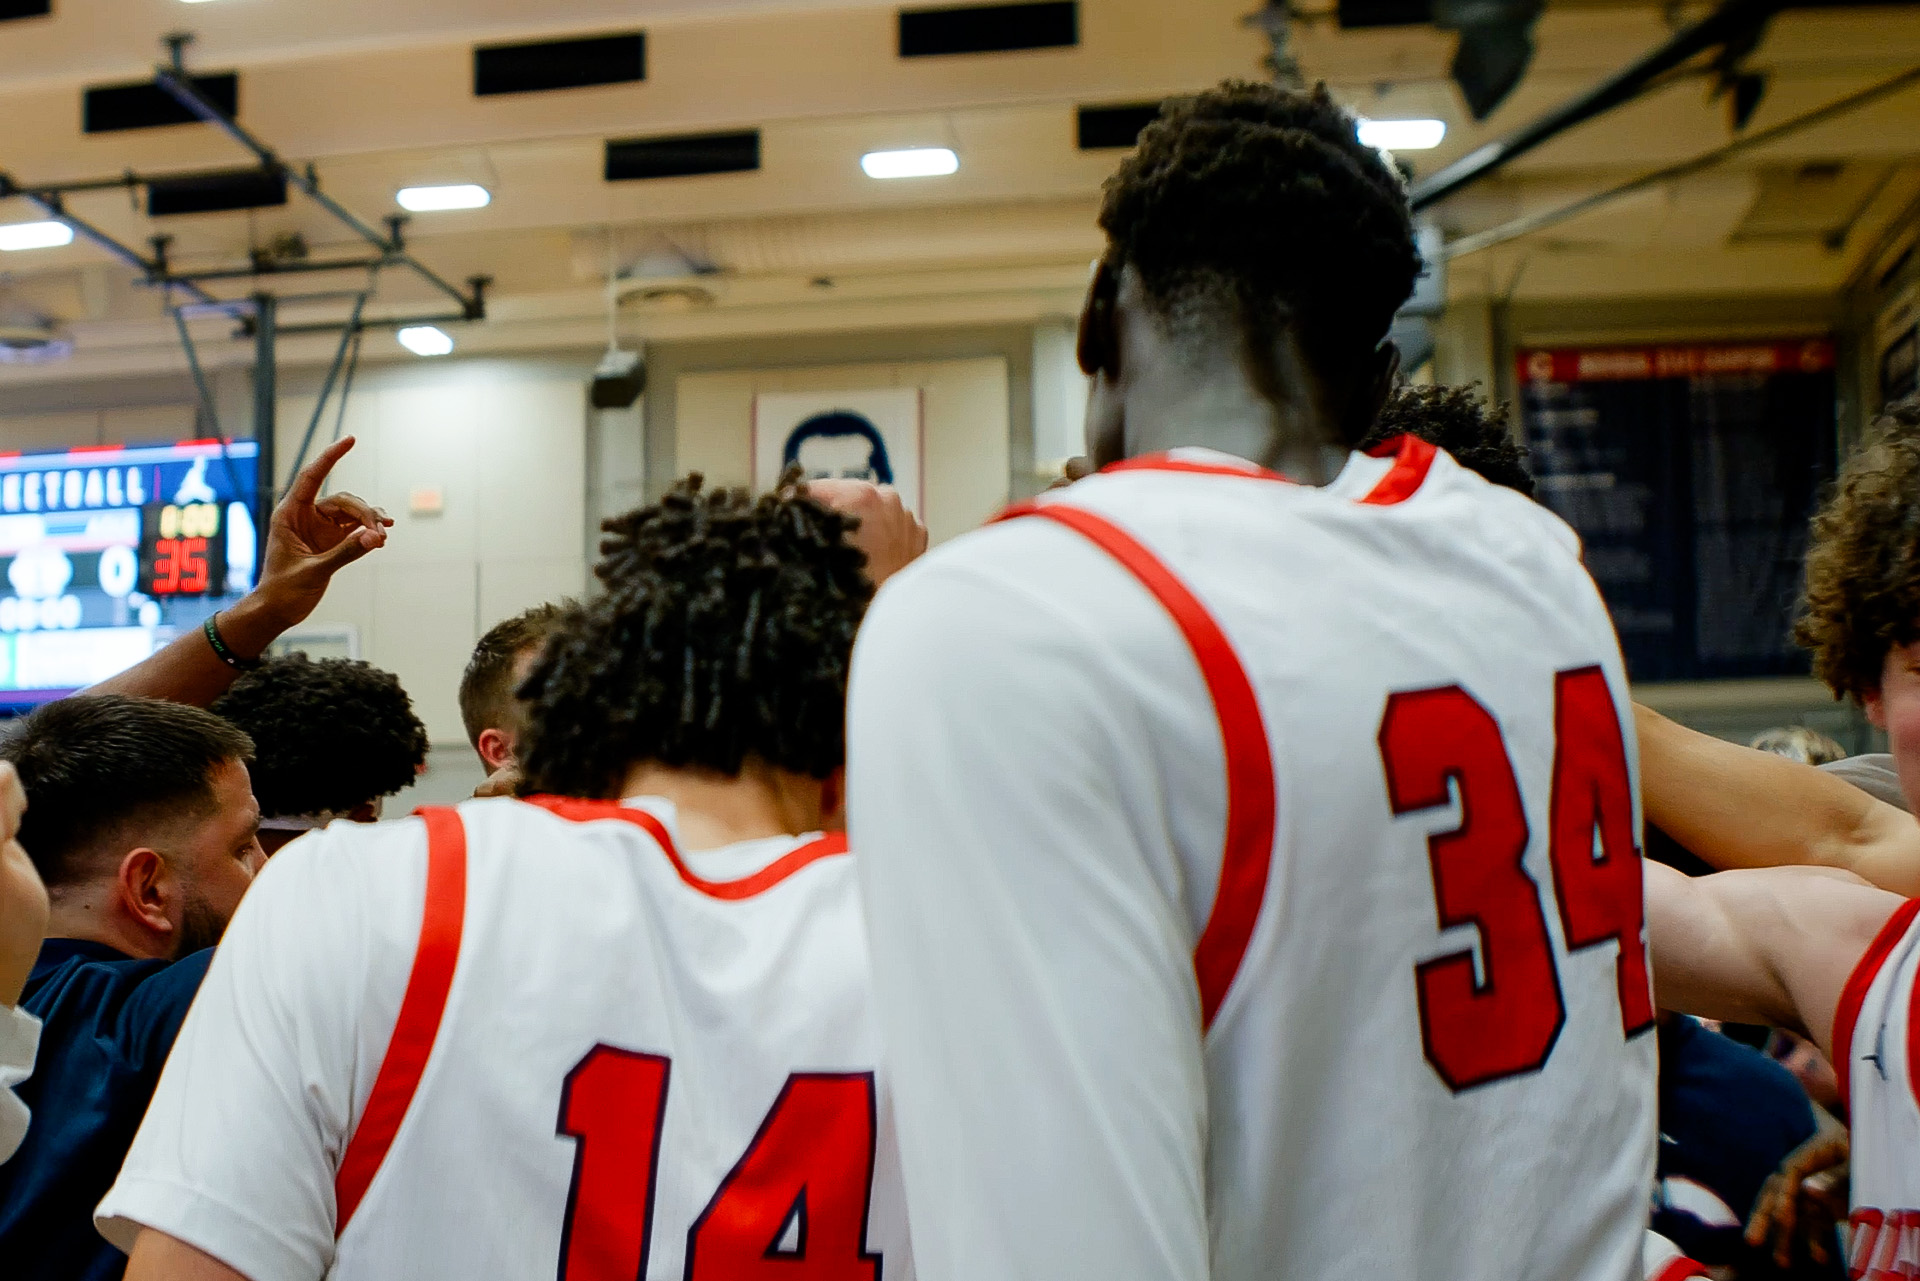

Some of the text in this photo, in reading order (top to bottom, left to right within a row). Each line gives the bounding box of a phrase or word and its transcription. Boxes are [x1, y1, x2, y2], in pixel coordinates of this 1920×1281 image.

[152, 537, 208, 593] 35
[1376, 664, 1657, 1093] 34
[555, 1042, 884, 1281] 14
